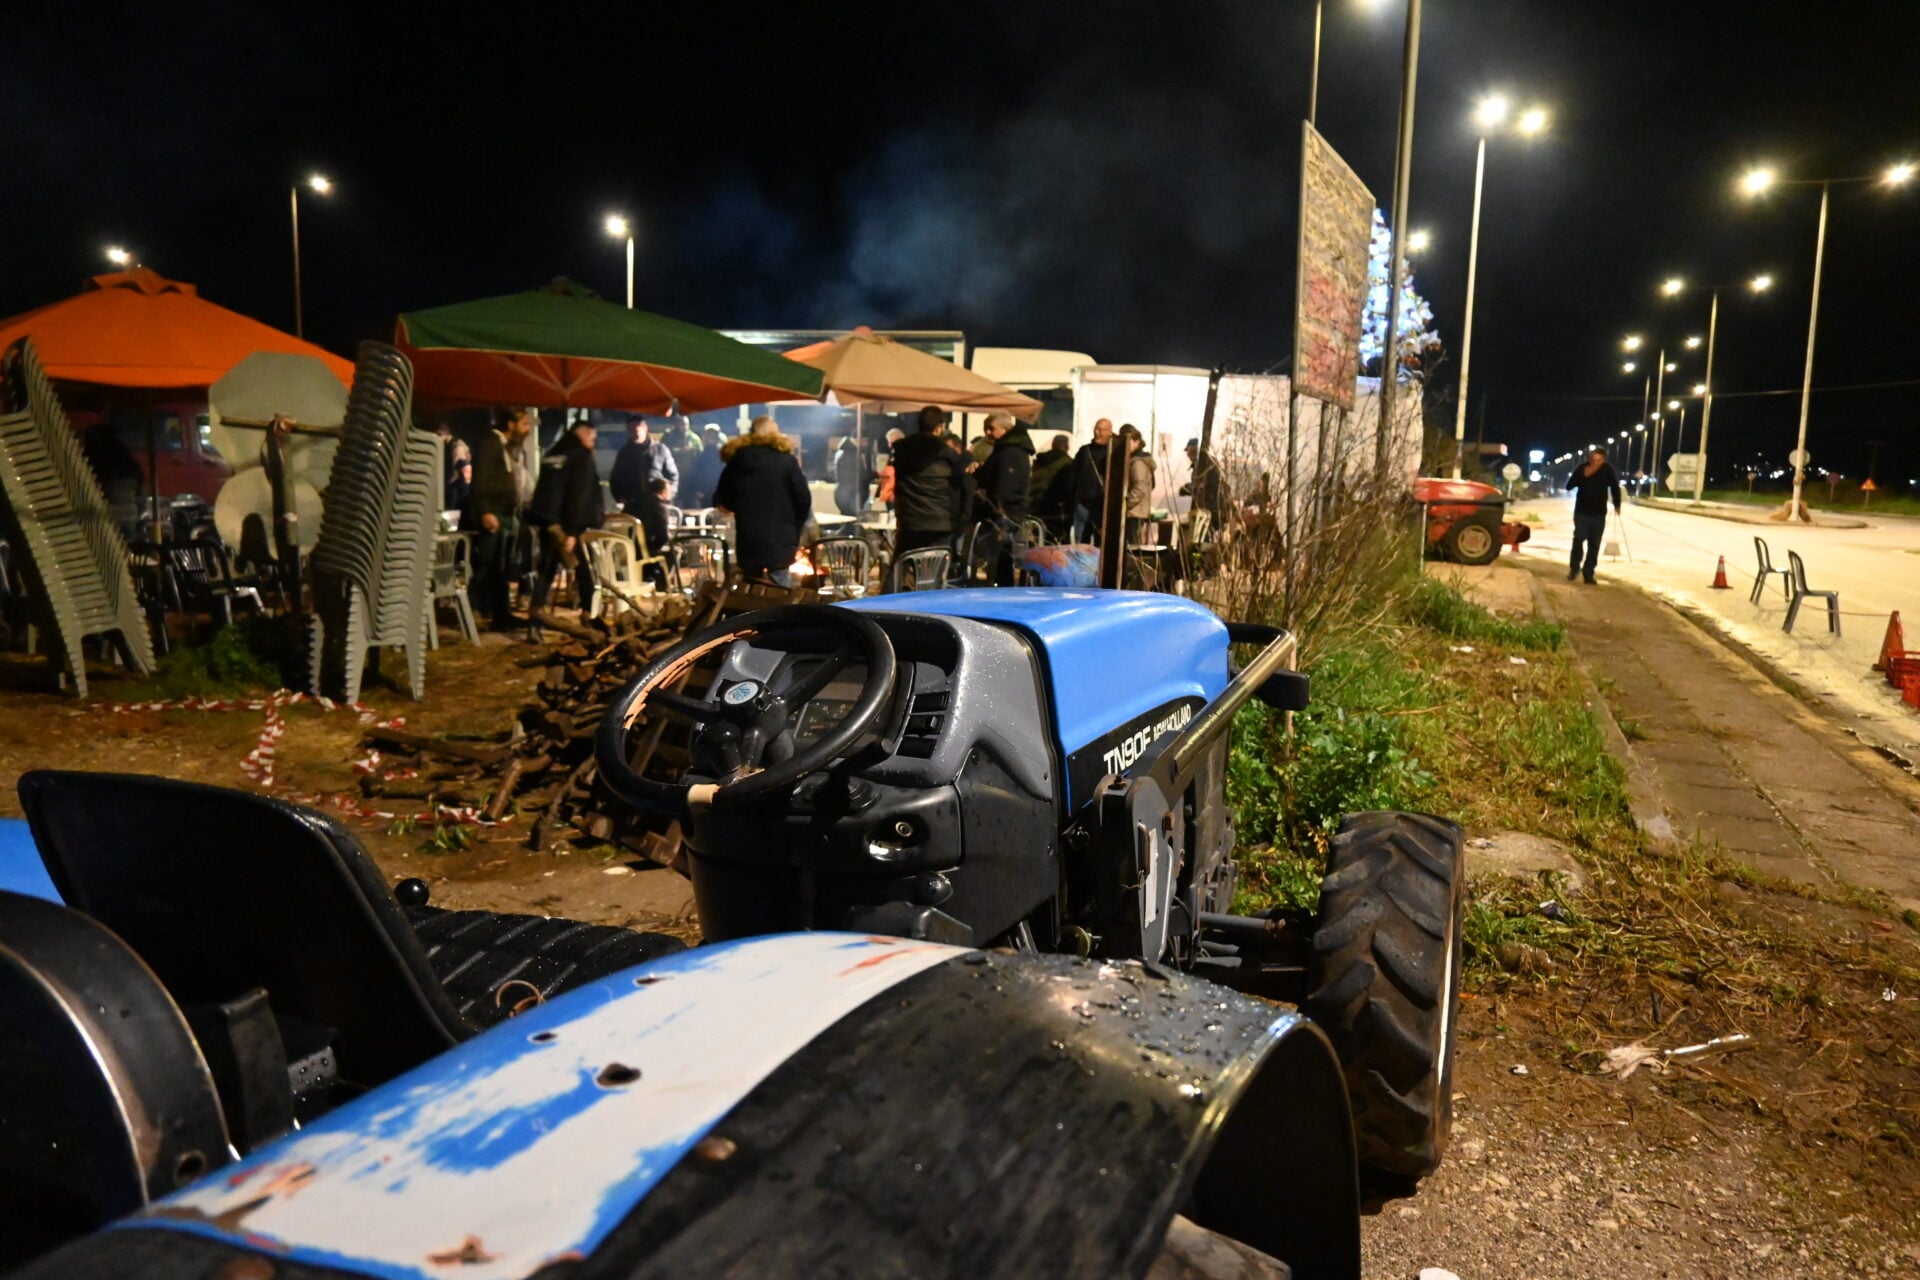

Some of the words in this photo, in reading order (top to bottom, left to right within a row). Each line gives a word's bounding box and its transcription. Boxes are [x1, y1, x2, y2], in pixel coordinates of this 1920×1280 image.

[1103, 725, 1151, 775] TN90F
[1153, 718, 1168, 742] NEW
[1166, 703, 1192, 731] HOLLAND
